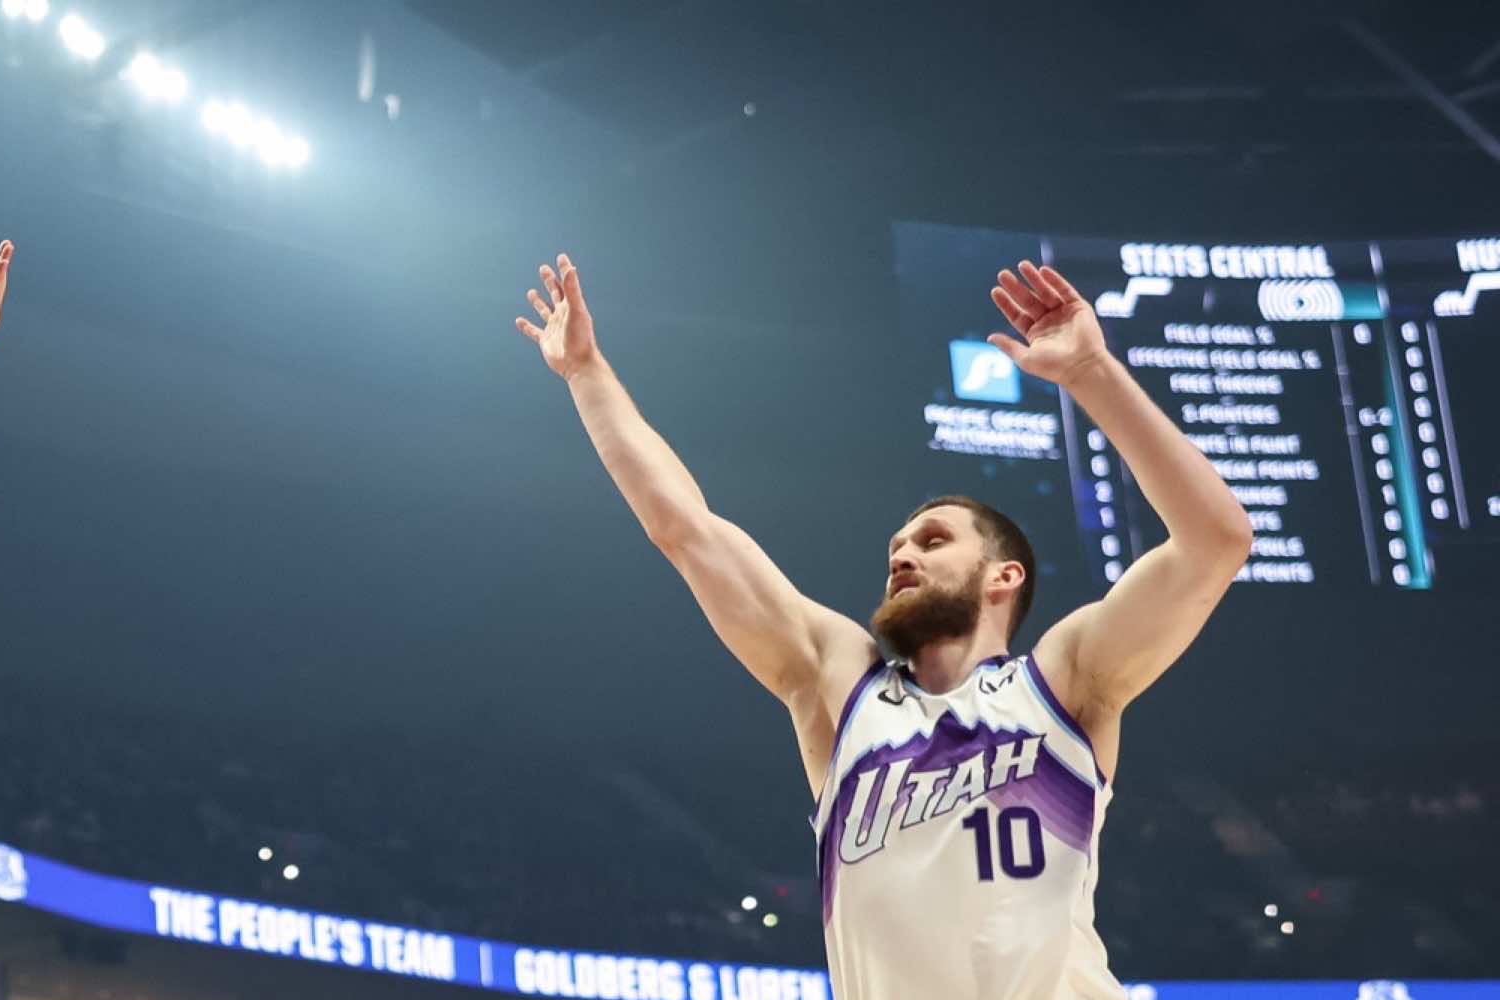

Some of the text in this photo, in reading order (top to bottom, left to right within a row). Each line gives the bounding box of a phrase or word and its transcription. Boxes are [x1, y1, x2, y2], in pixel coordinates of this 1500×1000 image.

[1120, 243, 1334, 278] STATS CENTRAL
[962, 805, 1046, 882] 10
[149, 886, 215, 943] THE
[217, 898, 365, 967] PEOPLE'S
[365, 922, 455, 981] TEAM
